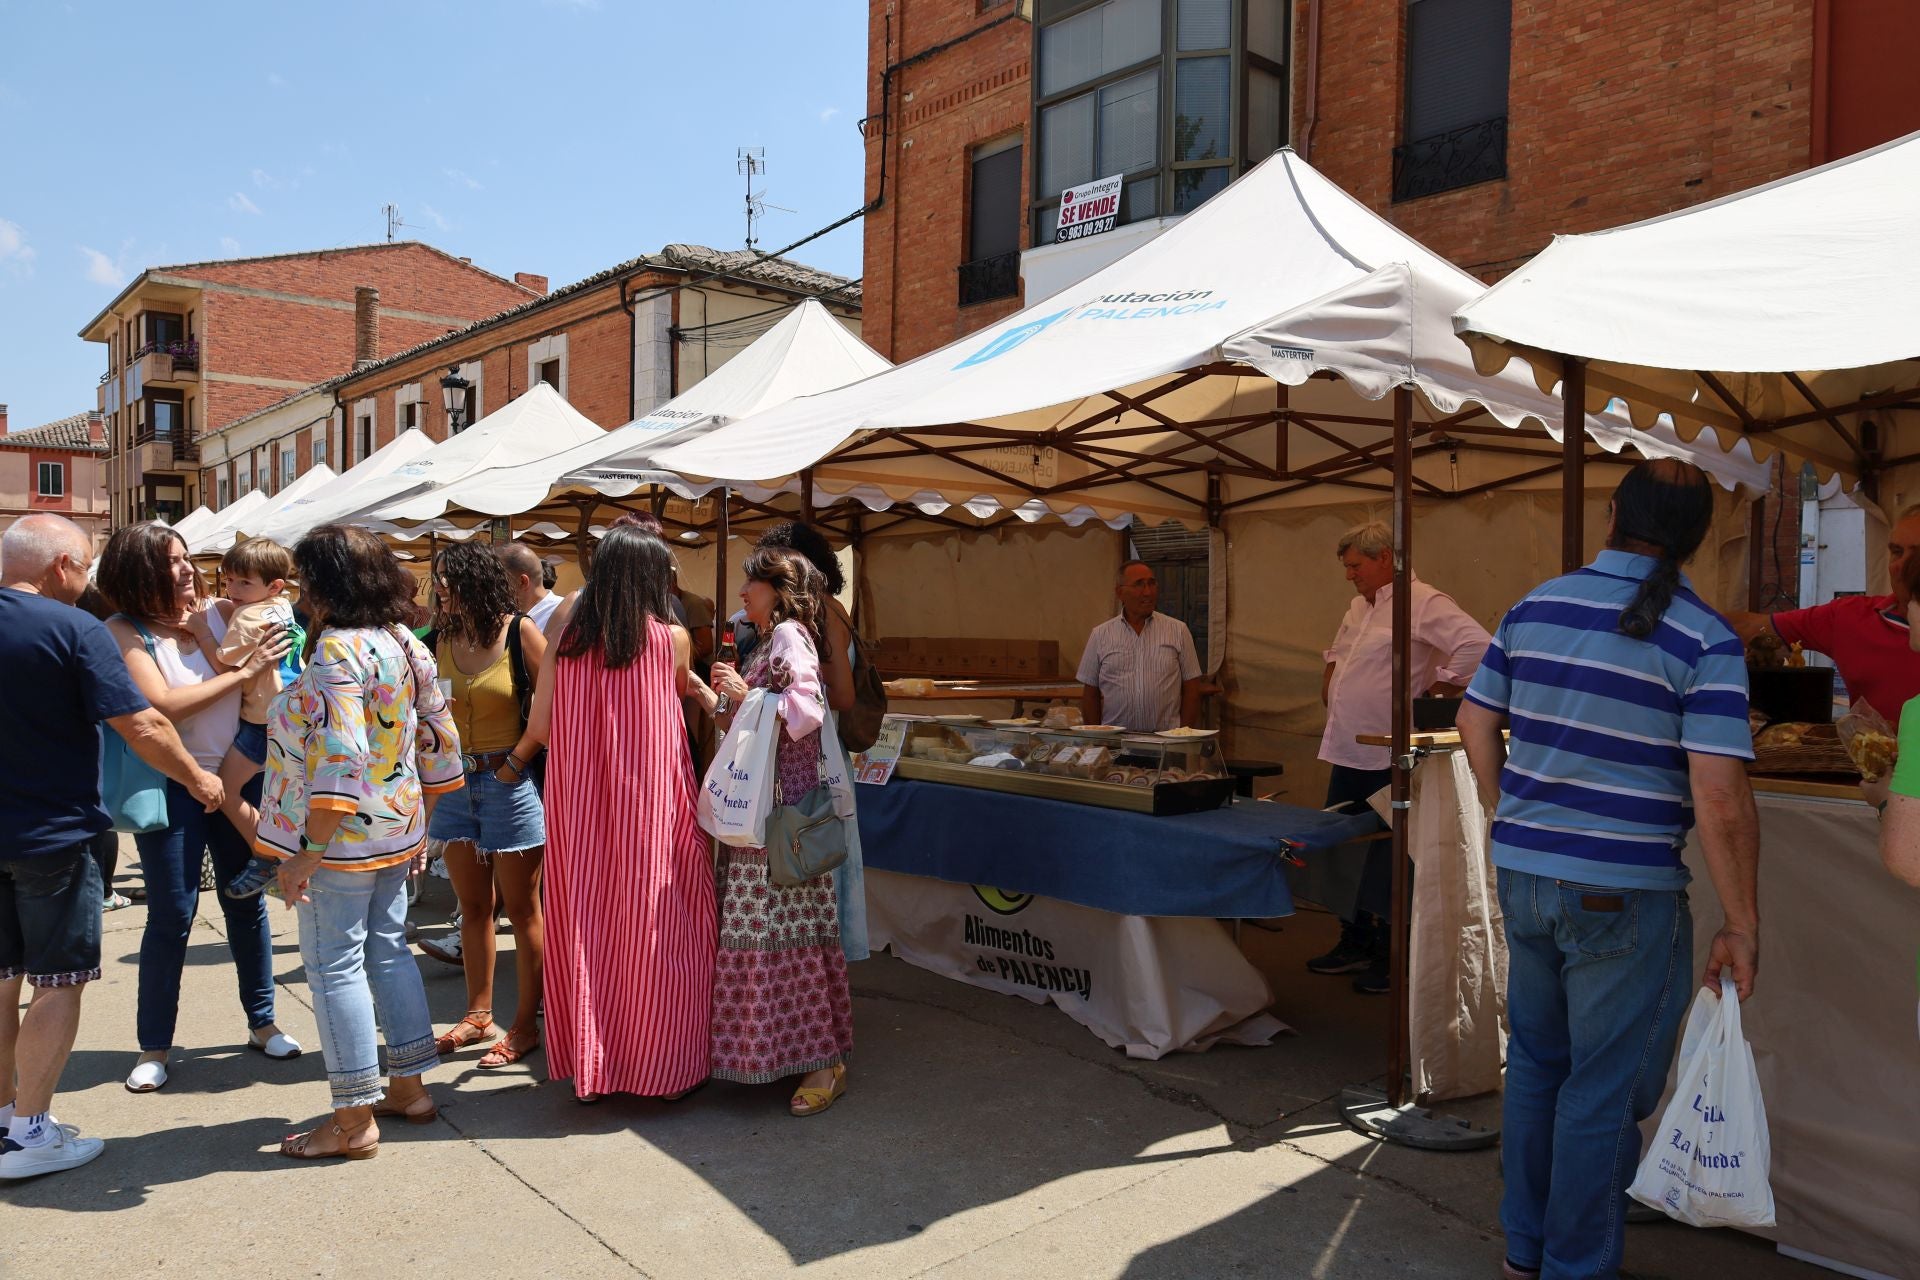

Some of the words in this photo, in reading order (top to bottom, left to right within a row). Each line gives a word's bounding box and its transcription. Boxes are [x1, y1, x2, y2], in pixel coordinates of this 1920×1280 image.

[1061, 205, 1076, 225] SE
[1078, 195, 1116, 220] VENDE
[1068, 225, 1082, 239] 983
[1104, 217, 1114, 231] 27
[1100, 290, 1214, 303] utación
[1076, 300, 1229, 320] PALENCIA
[1271, 349, 1314, 361] MASTERTENT
[964, 913, 1055, 961] Alimentos
[976, 955, 996, 973] de
[997, 956, 1092, 1001] PALENCIA
[1670, 1128, 1691, 1154] La
